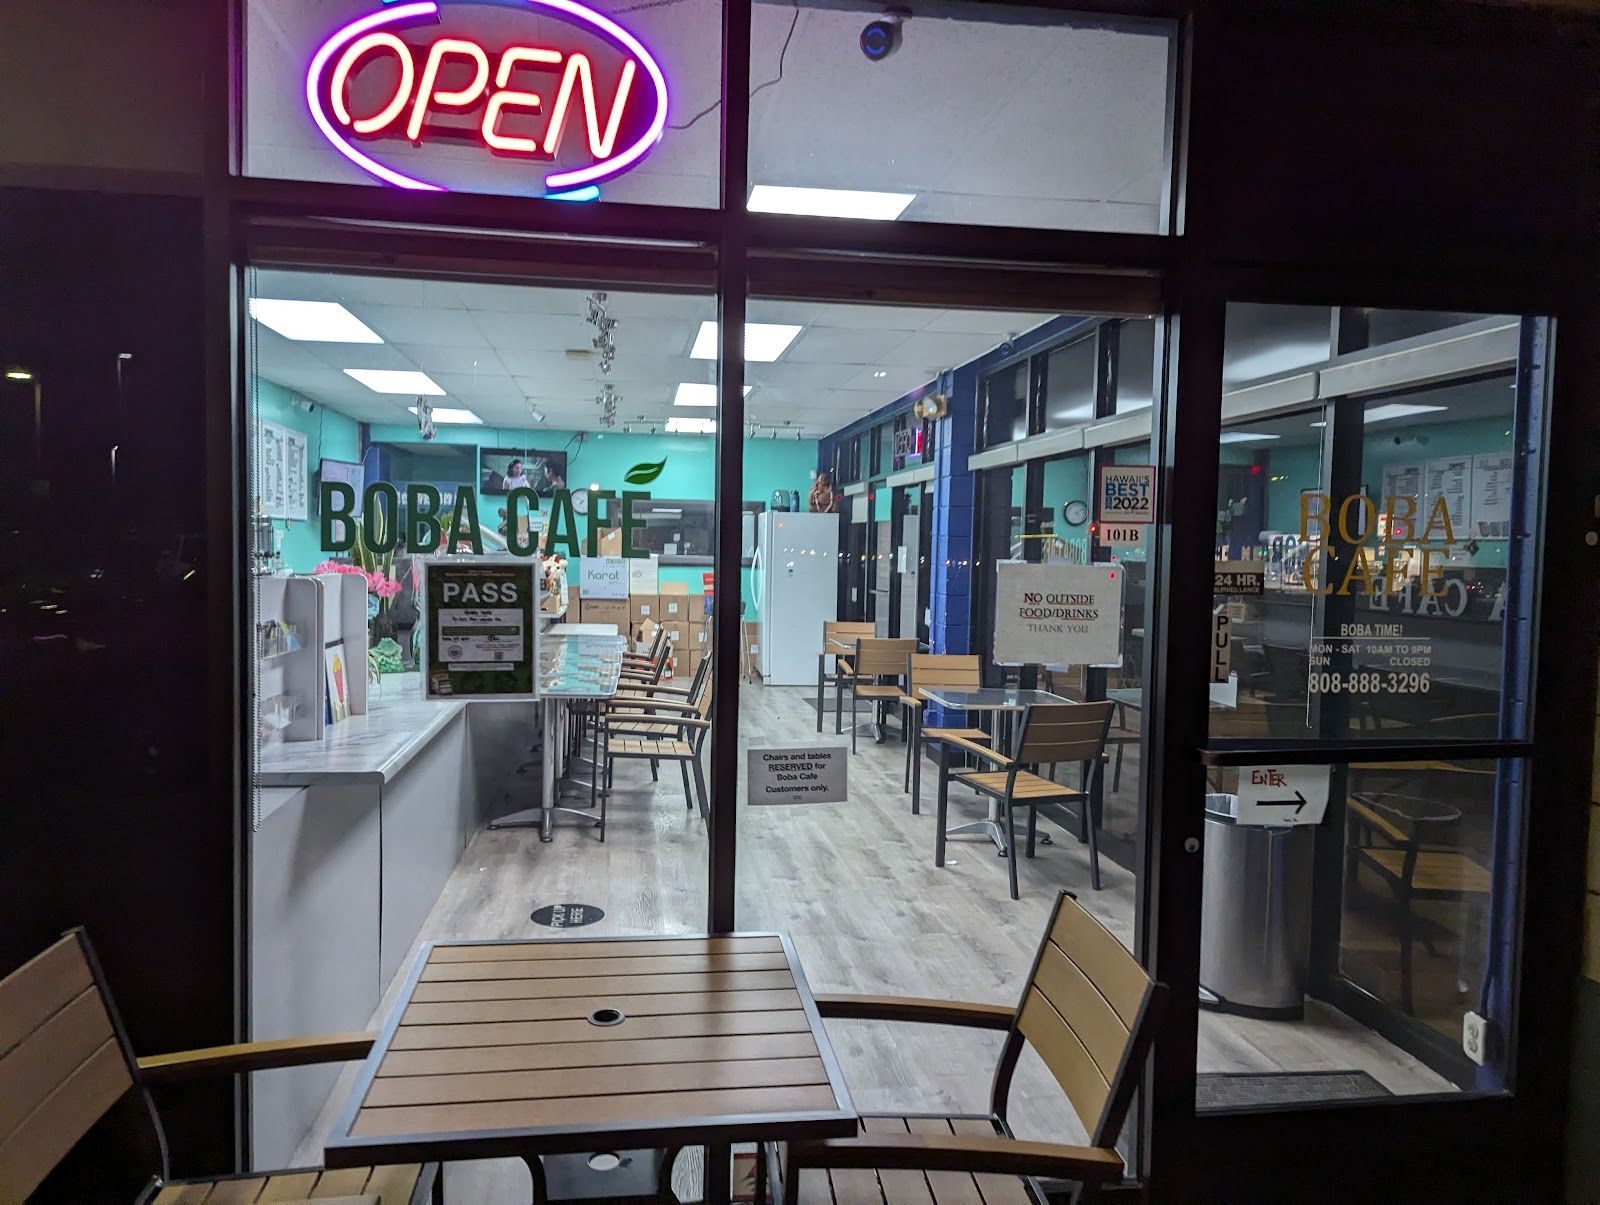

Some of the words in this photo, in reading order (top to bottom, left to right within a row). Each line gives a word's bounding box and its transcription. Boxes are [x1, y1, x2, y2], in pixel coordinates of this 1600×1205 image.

[330, 31, 636, 160] OPEN
[1105, 474, 1150, 484] HAWAII'S
[1105, 483, 1148, 497] BEST
[1112, 496, 1149, 510] 2022
[320, 480, 484, 556] BOBA
[1299, 492, 1457, 545] BOBA
[1106, 528, 1139, 541] 101B
[587, 569, 620, 581] Karat
[1303, 544, 1450, 598] CAFE
[1214, 574, 1233, 586] 24
[1236, 574, 1261, 586] HR.
[442, 582, 518, 603] PASS
[1023, 593, 1042, 604] NO
[1046, 593, 1095, 605] OUTSIDE
[1019, 607, 1099, 619] FOOD/DRINKS
[1028, 624, 1063, 633] THANK
[1067, 624, 1089, 634] YOU
[1340, 624, 1372, 637] BOBA
[1374, 624, 1404, 637] TIME!
[1214, 615, 1229, 682] PULL
[1309, 644, 1333, 654] MON
[1341, 645, 1361, 654] SAT
[1366, 645, 1393, 654] 10AM
[1395, 645, 1409, 654] TO
[1309, 656, 1331, 666] SUN
[1389, 657, 1431, 667] CLOSED
[1309, 672, 1430, 694] 808-888-3296
[790, 753, 806, 761] and
[807, 752, 832, 760] tables
[768, 763, 813, 772] RESERVED
[815, 762, 826, 770] for
[1251, 769, 1287, 787] ENTER
[765, 785, 809, 793] Customers
